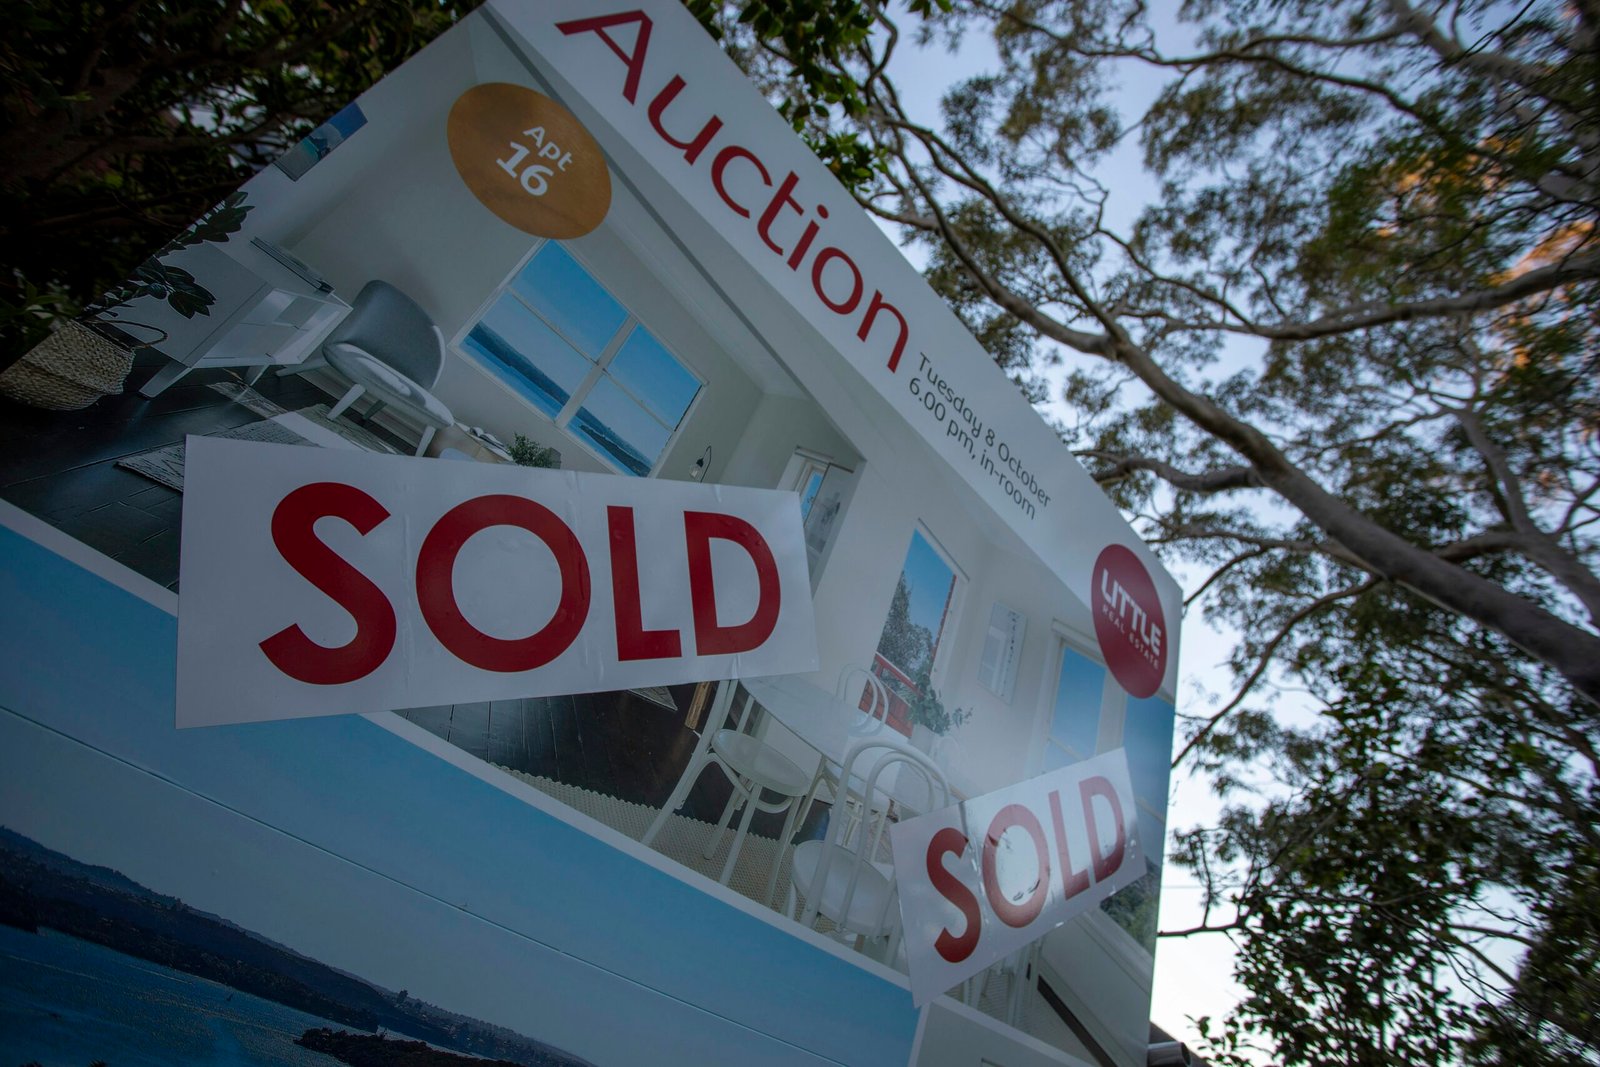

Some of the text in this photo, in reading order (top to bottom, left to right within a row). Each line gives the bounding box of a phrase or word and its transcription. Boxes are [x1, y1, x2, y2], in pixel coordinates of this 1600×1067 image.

[496, 141, 554, 196] 16
[522, 126, 573, 172] Apt
[554, 9, 909, 374] Auction
[909, 377, 1036, 520] 6.00 pm, in-room
[920, 352, 1051, 507] Tuesday 8 October
[258, 481, 781, 685] SOLD
[1101, 567, 1162, 657] LITTLE
[1102, 604, 1160, 671] REAL ESTATE
[926, 775, 1126, 964] SOLD
